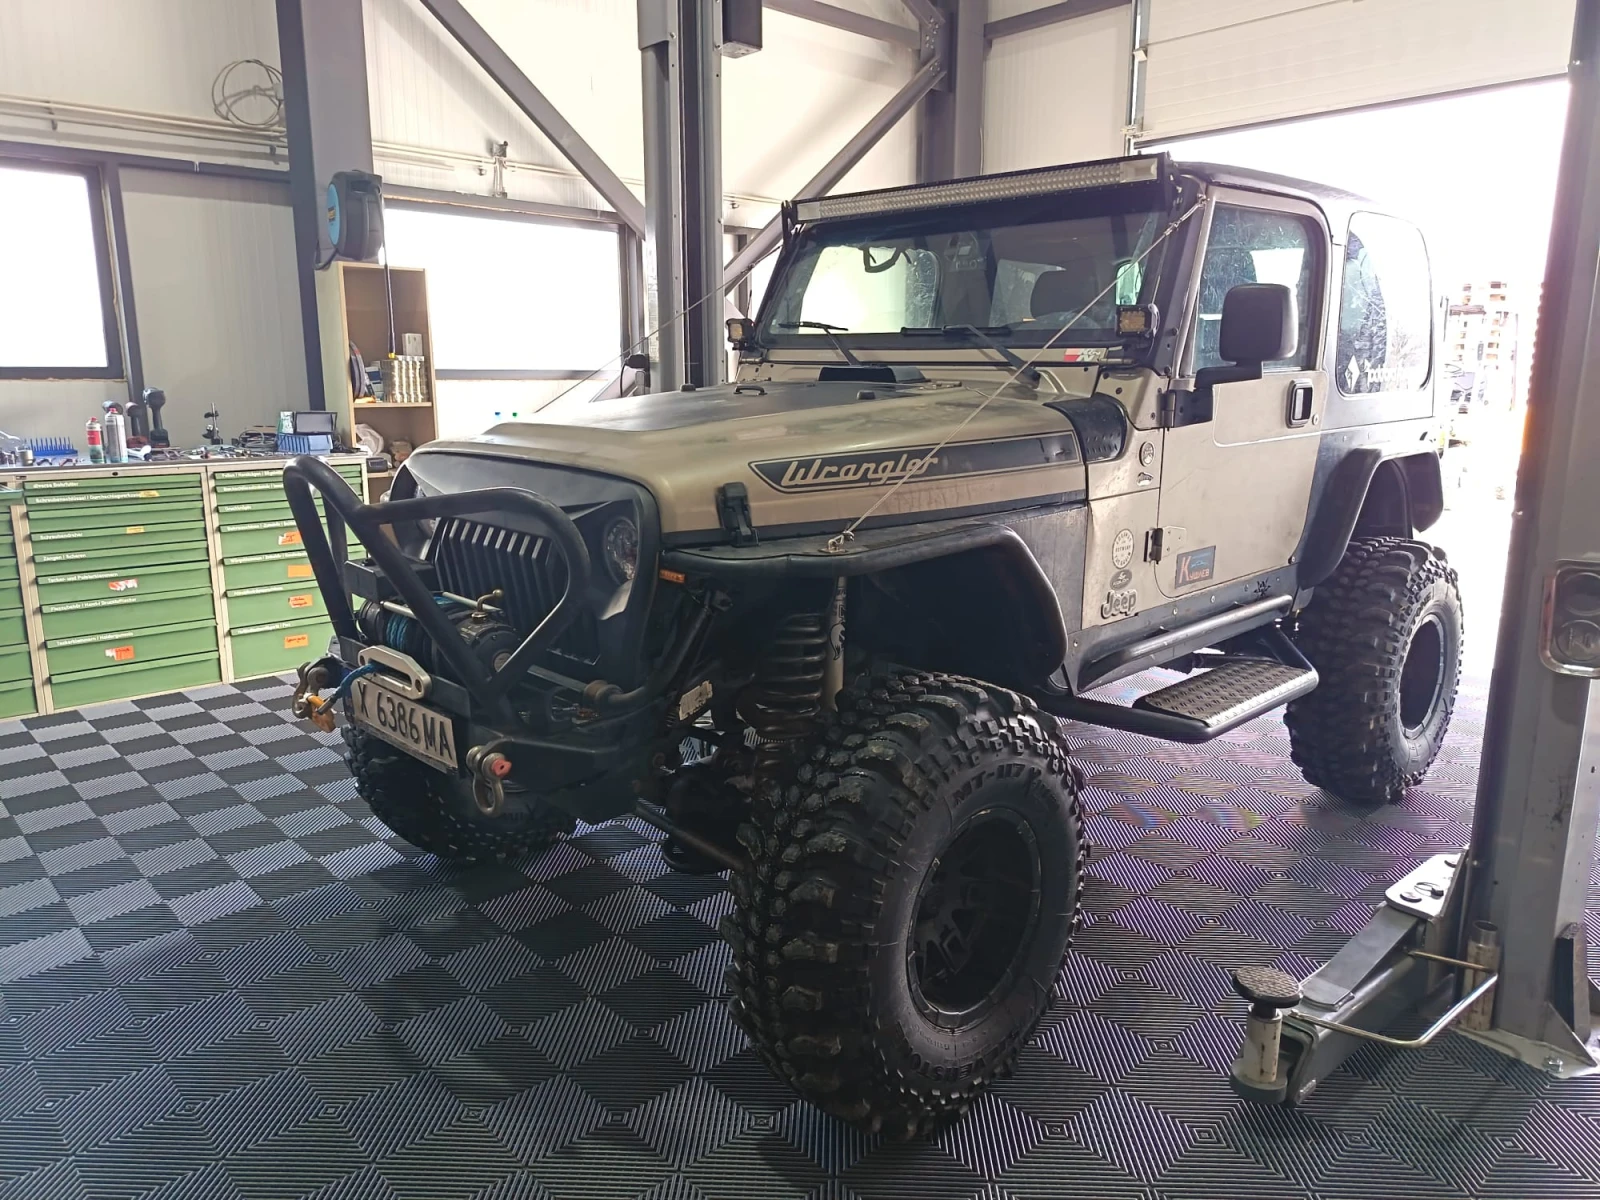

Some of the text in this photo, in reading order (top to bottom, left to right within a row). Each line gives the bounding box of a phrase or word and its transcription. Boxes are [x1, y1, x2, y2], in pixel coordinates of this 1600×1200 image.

[780, 453, 939, 488] Wrangler
[1102, 590, 1137, 617] Jeep
[357, 680, 453, 760] X 6386 MA
